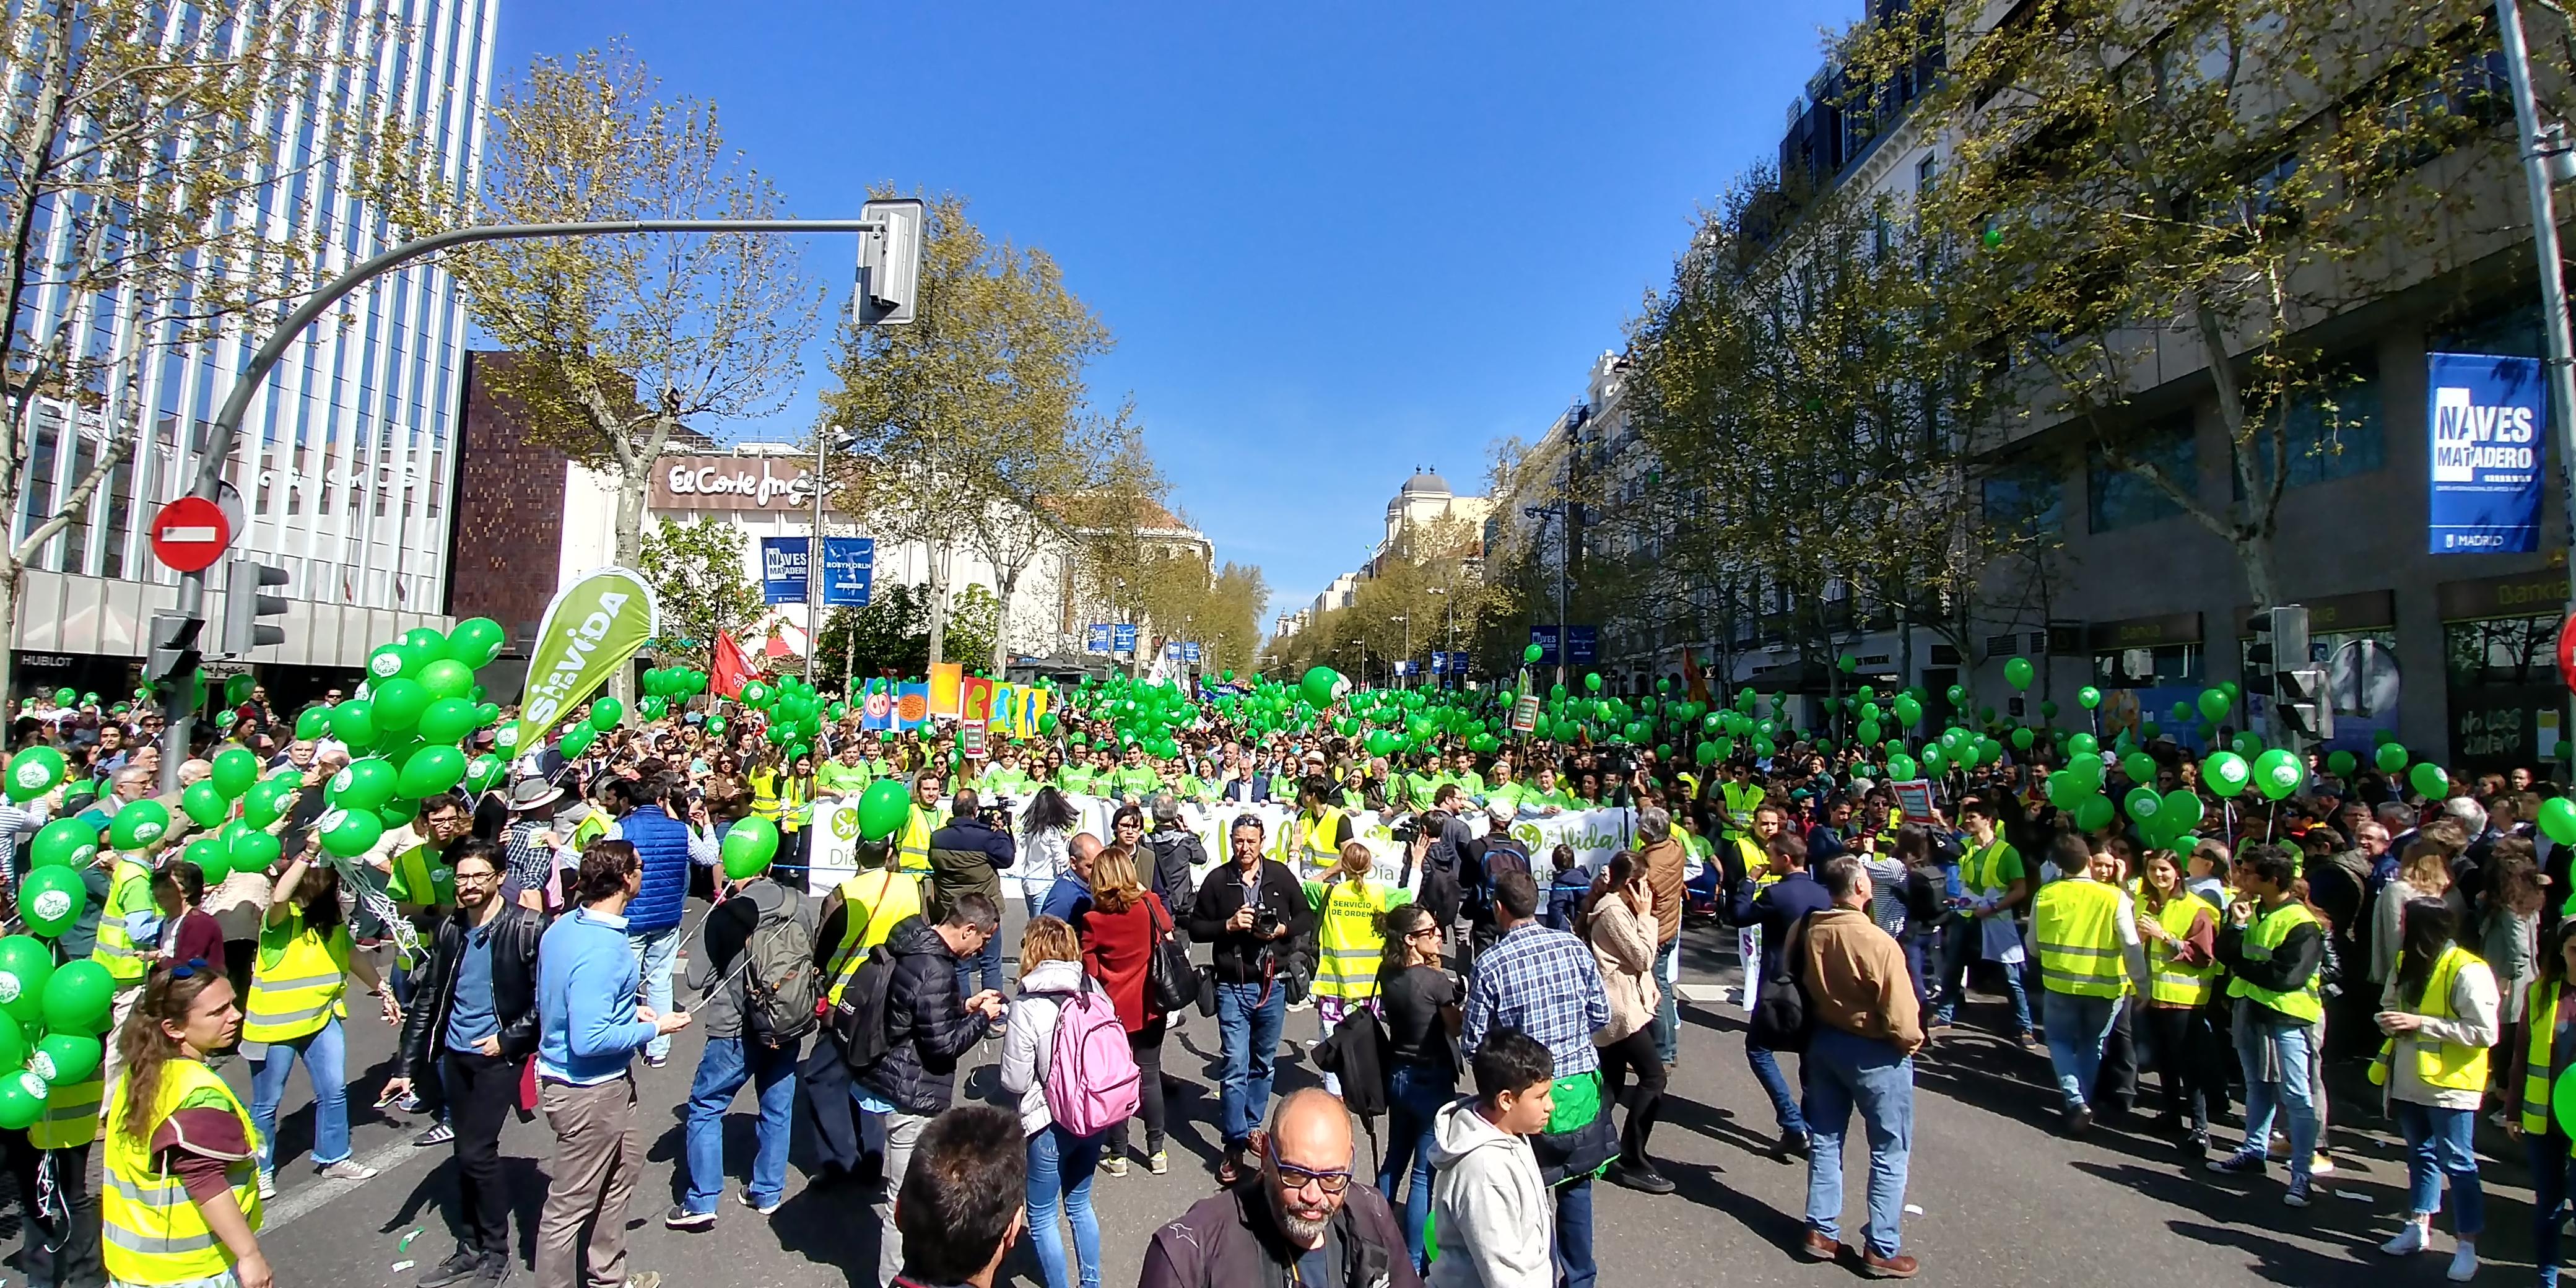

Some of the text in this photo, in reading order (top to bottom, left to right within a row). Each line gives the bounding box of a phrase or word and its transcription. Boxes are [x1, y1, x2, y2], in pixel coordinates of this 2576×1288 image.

[2439, 406, 2533, 443] NAVES
[2438, 446, 2532, 468] MATADERO
[669, 464, 695, 493] El
[696, 466, 755, 495] Corte
[2458, 535, 2504, 546] MADRID
[769, 552, 807, 566] NAVES
[770, 567, 807, 575] MATADERO
[22, 655, 73, 668] HUBLOT
[1333, 900, 1372, 908] SERVICIO
